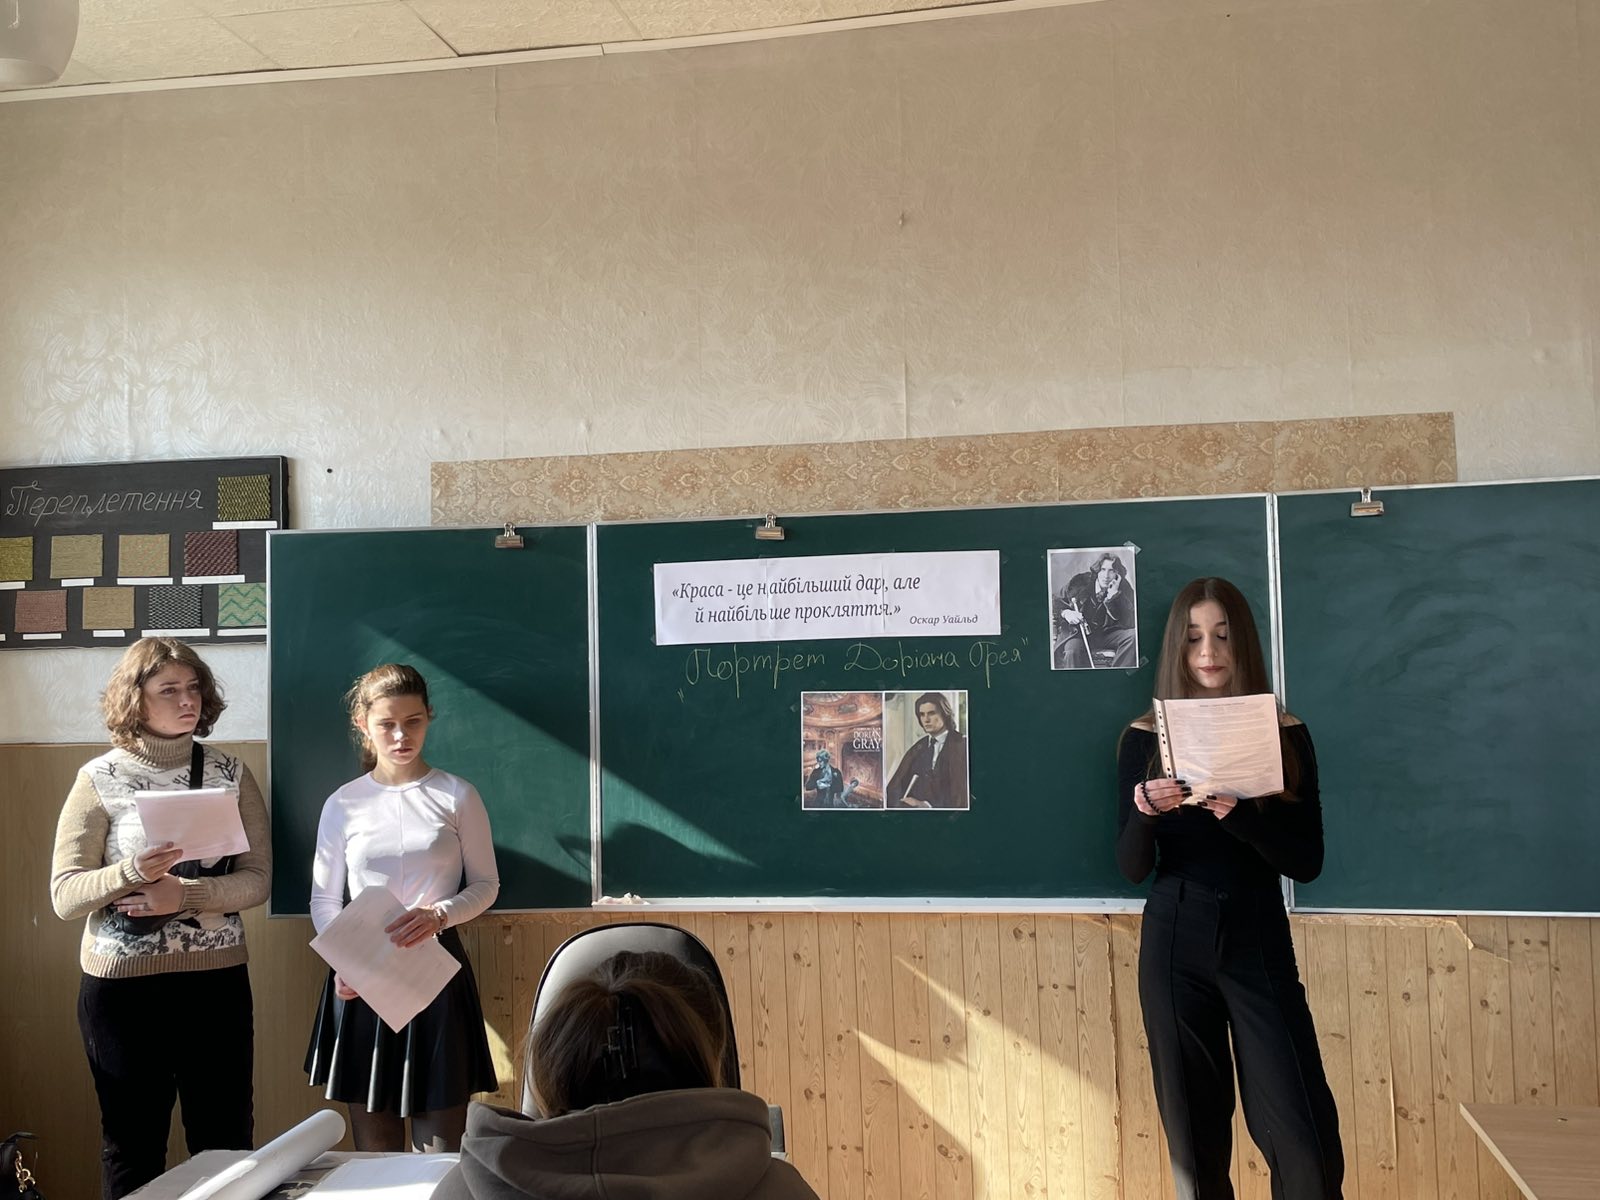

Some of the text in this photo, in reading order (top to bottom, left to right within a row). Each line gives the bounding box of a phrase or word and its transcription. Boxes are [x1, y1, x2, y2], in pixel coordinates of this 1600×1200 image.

[5, 480, 204, 527] Переплетення
[672, 582, 724, 603] «Краса
[736, 582, 754, 600] це
[757, 575, 852, 596] найбільший
[855, 573, 889, 595] дар,
[893, 576, 921, 590] але
[695, 602, 901, 624] й найбільше прокляття.»
[909, 614, 979, 626] Оскар Уайльд
[844, 640, 960, 678] Доріана
[852, 738, 882, 750] GRAY
